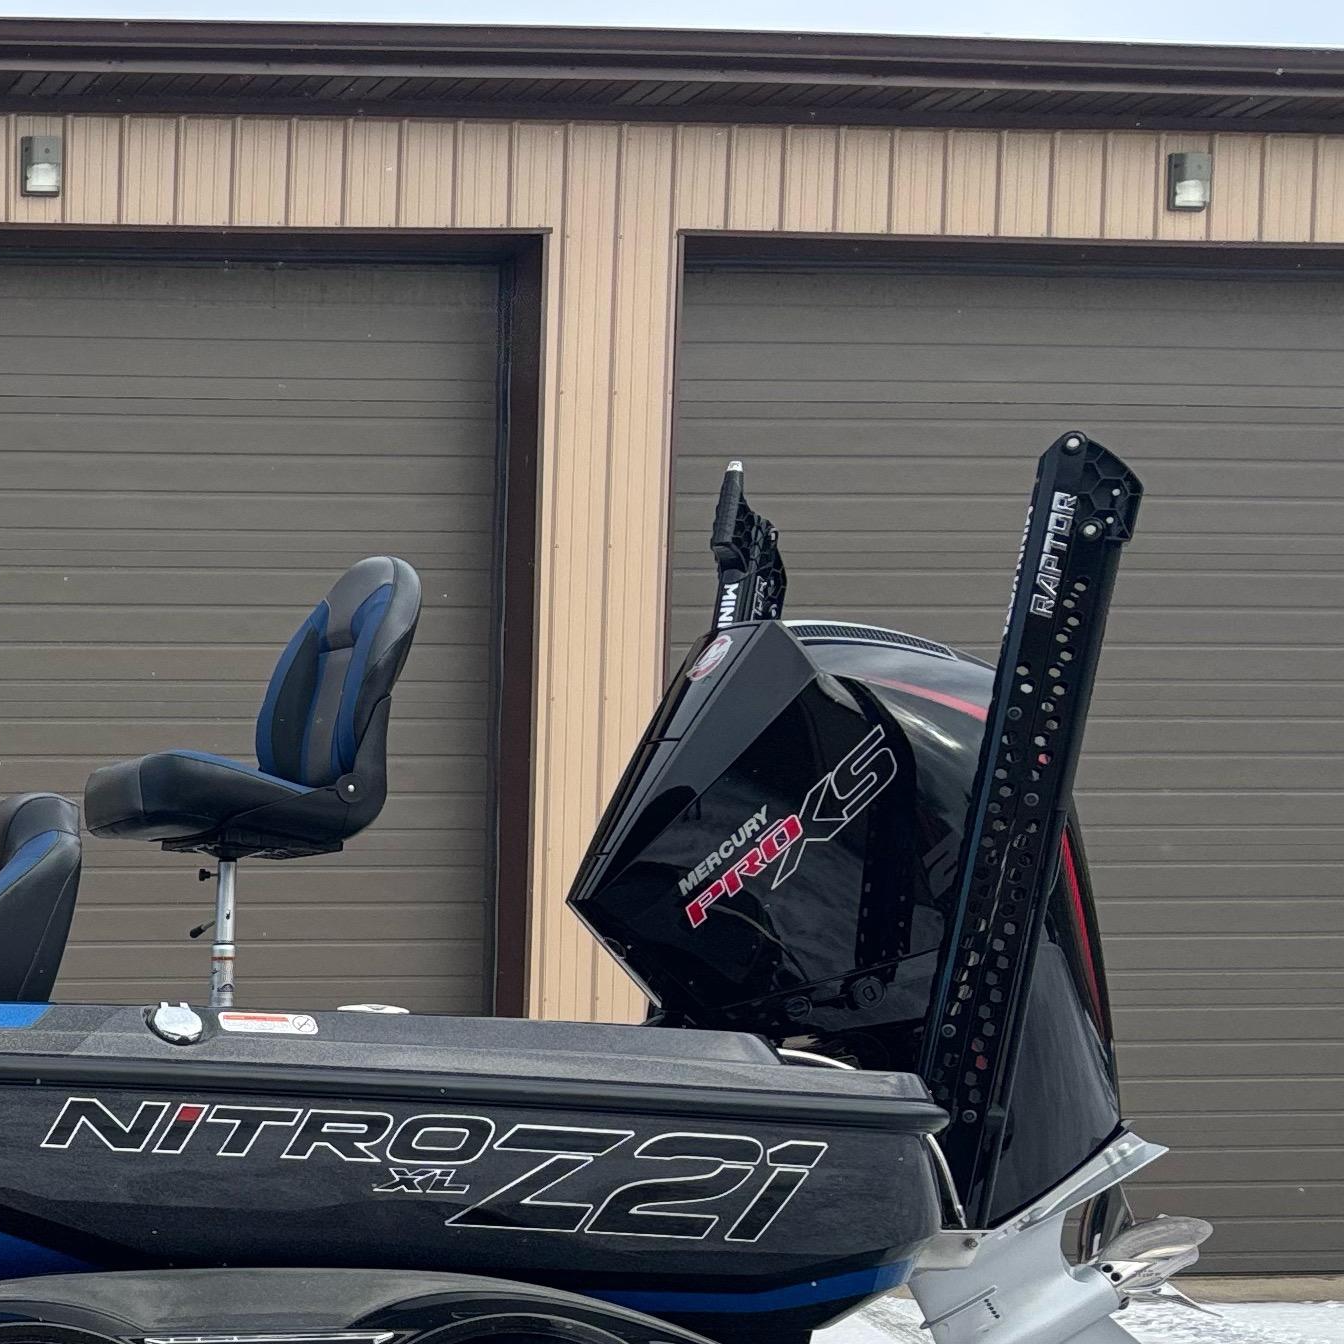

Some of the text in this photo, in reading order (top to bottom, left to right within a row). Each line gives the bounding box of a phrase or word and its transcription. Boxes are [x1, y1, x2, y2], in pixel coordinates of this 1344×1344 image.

[1029, 491, 1078, 618] RAPTOR
[678, 804, 770, 897] MERCURY
[684, 814, 804, 929] PRO
[372, 1166, 471, 1194] XL
